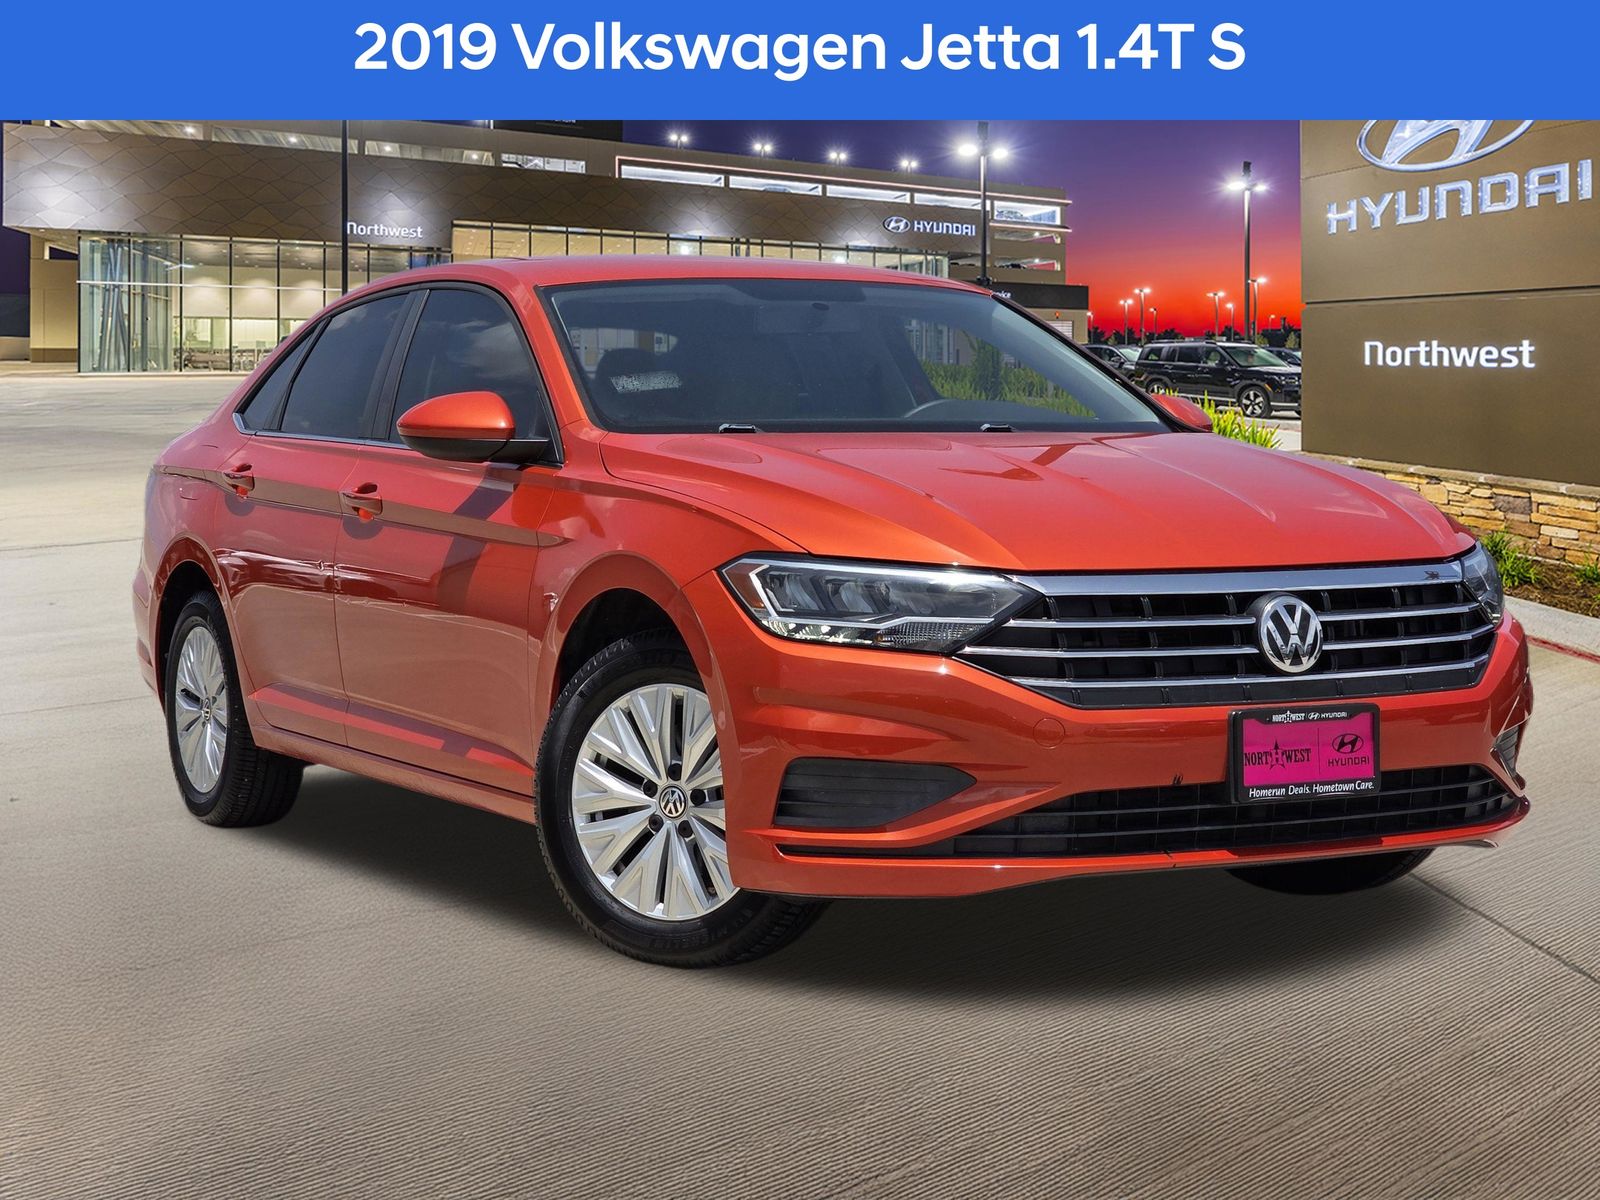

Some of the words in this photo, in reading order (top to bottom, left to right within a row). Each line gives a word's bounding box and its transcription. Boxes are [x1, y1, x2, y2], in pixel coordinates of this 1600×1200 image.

[1326, 158, 1593, 235] HYUNDAI
[346, 221, 424, 238] Northwest
[913, 219, 976, 237] HYUNDAI
[1363, 339, 1536, 369] Northwest
[1320, 711, 1348, 719] HYUNDAI
[1327, 756, 1370, 767] HYUNDAI
[1249, 786, 1286, 798] Homerun
[1288, 785, 1312, 795] Deals.
[1312, 782, 1355, 794] Hometown
[1355, 780, 1374, 790] Care.
